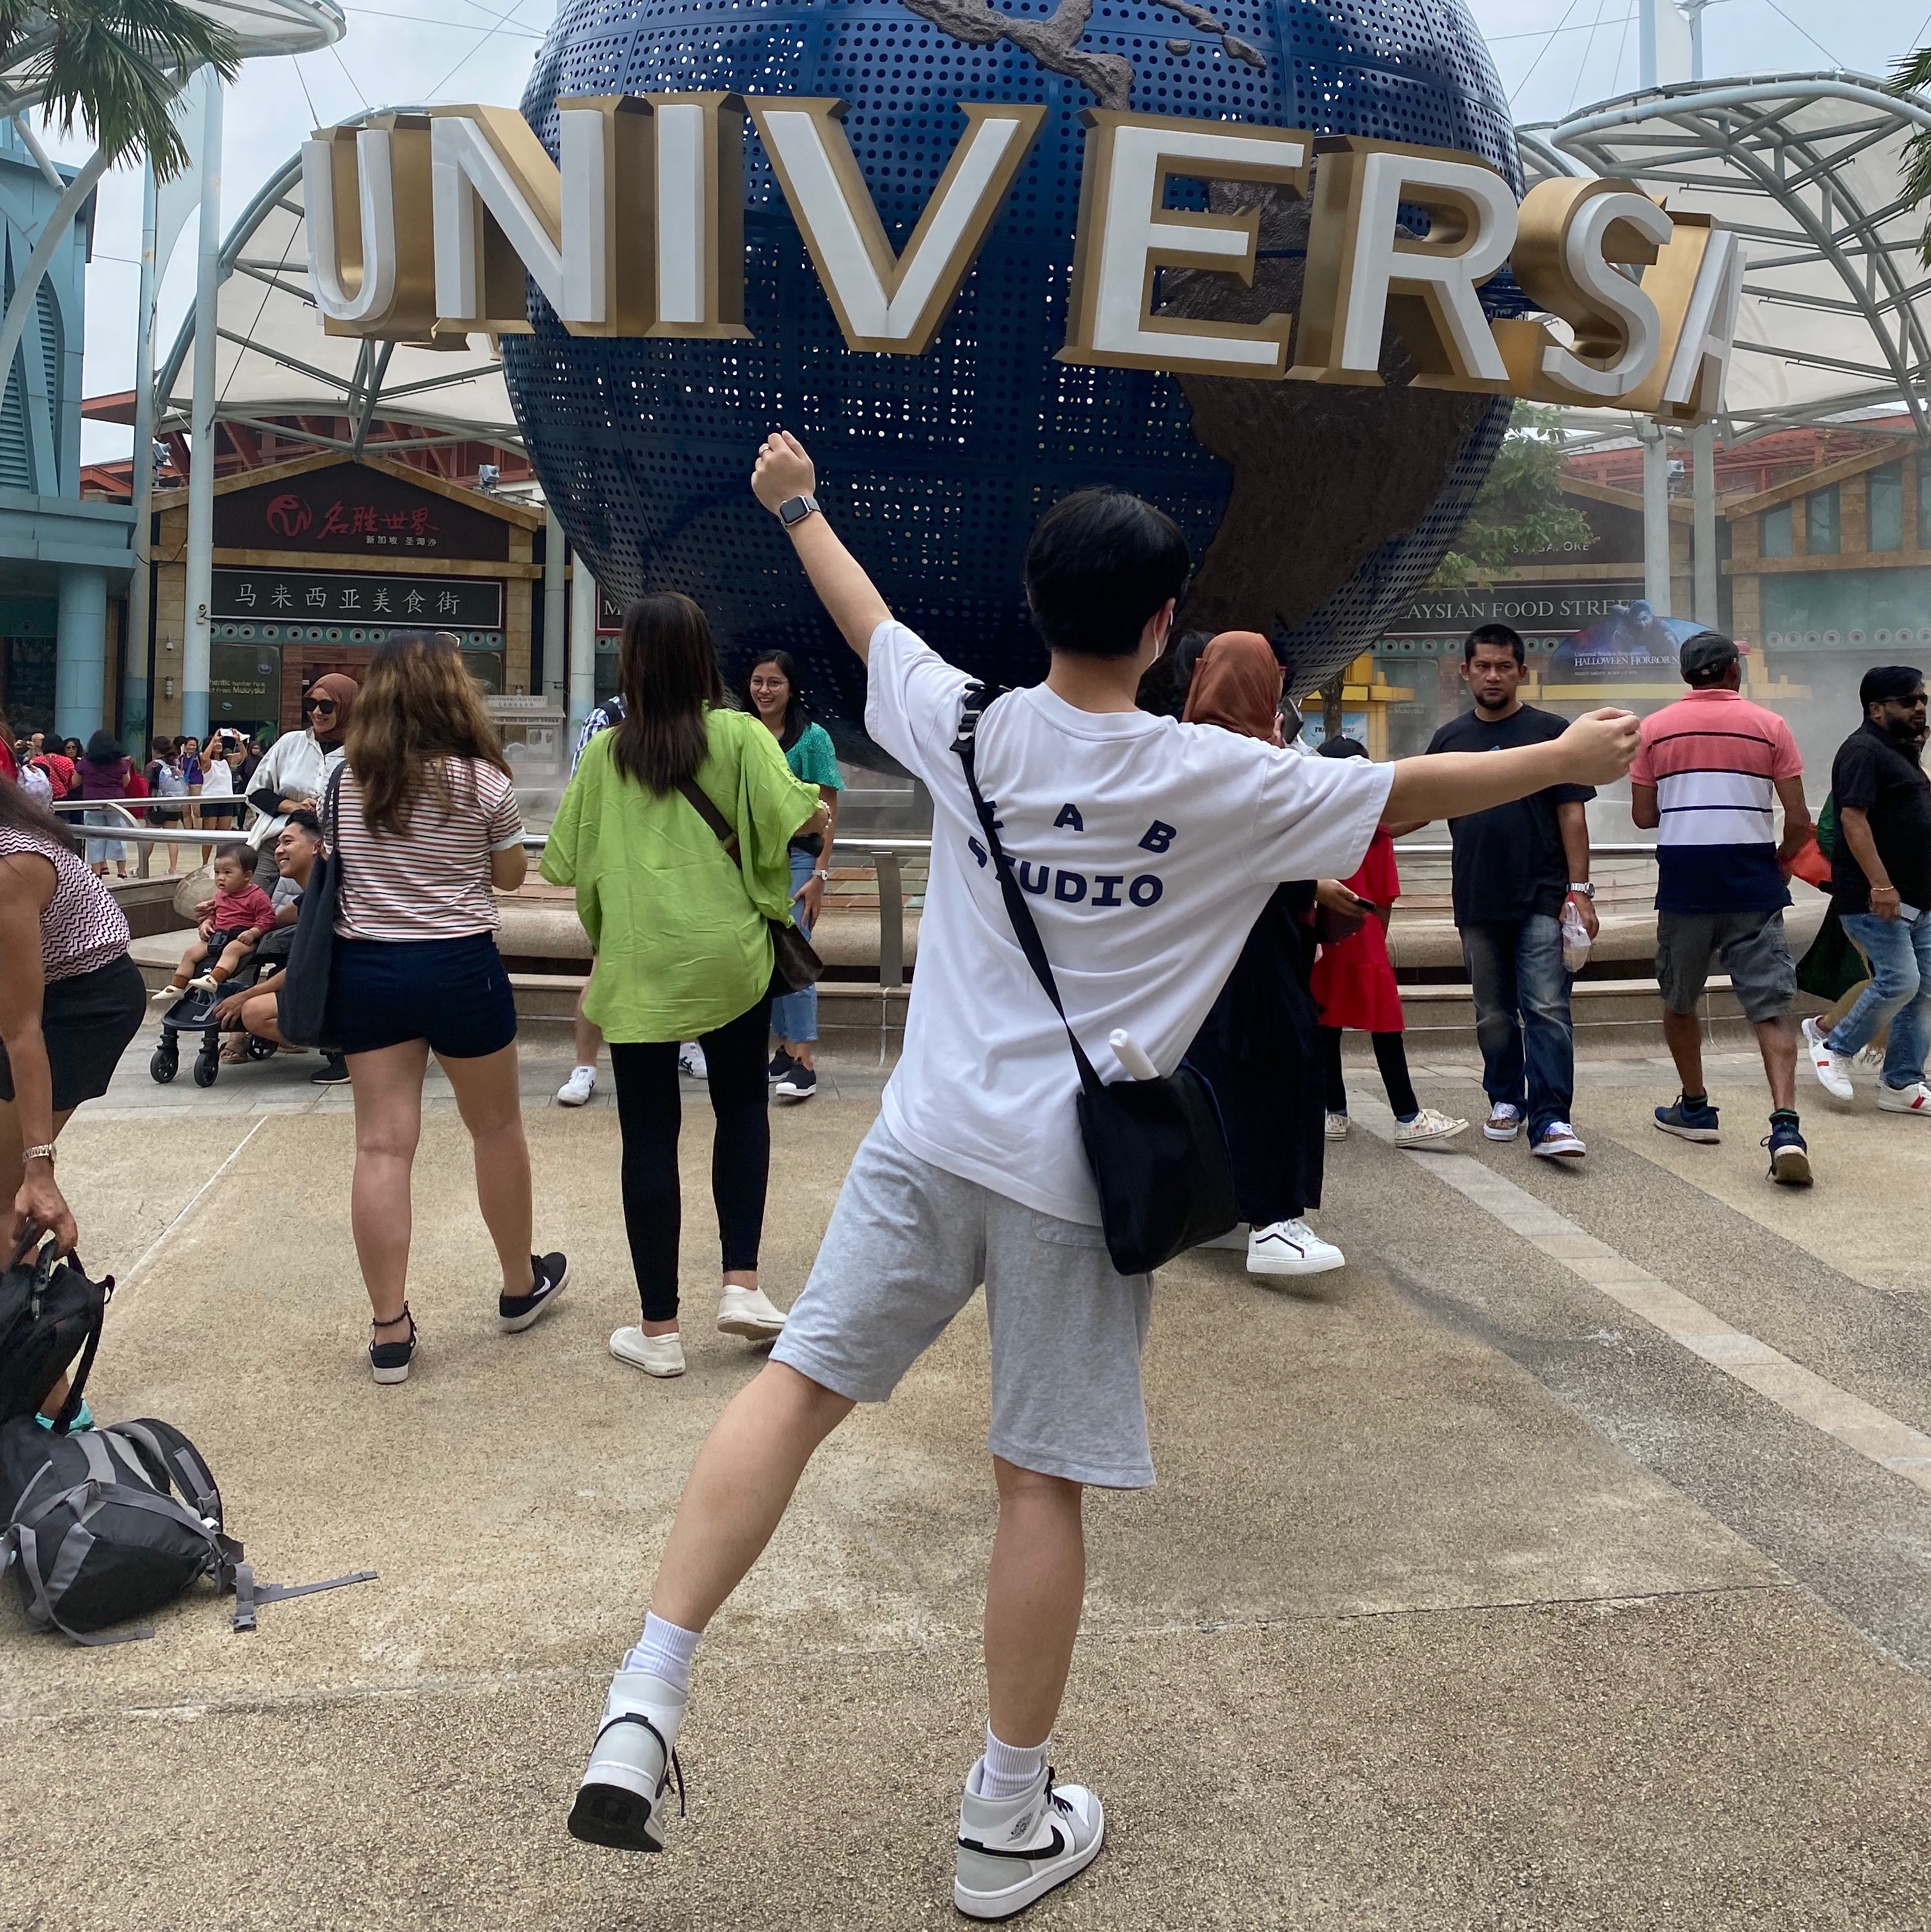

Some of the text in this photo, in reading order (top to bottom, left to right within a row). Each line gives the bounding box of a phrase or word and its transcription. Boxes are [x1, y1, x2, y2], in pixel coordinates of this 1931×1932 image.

[317, 501, 440, 539] 名胜世界
[235, 583, 460, 615] 马来西亚美食街
[1492, 601, 1554, 618] FOOD
[1575, 657, 1629, 666] HALLOWEEN
[1631, 655, 1670, 665] HORROR
